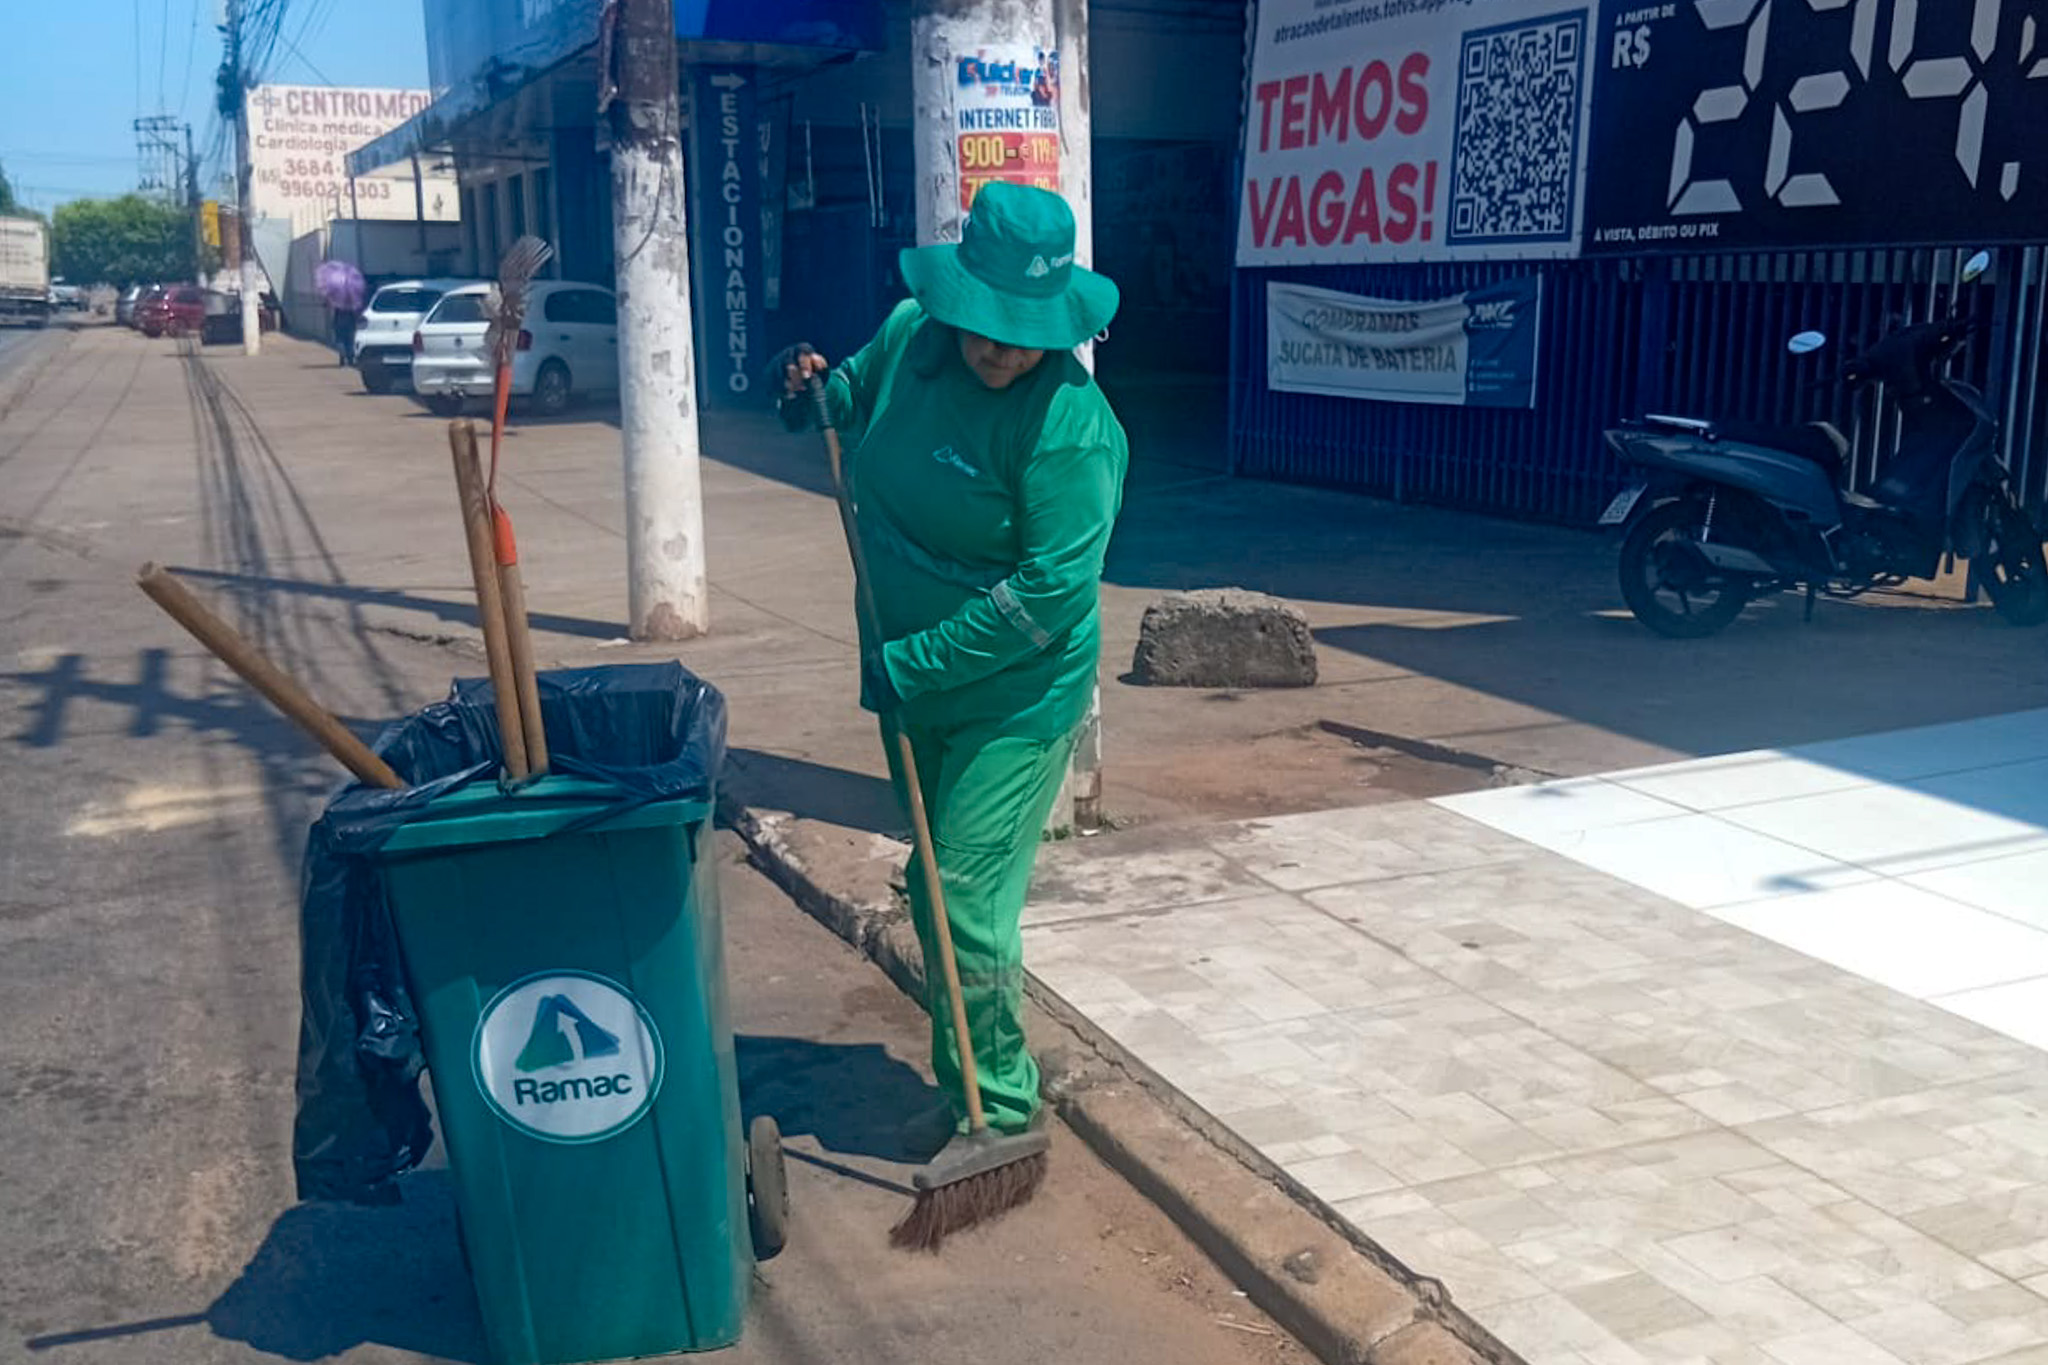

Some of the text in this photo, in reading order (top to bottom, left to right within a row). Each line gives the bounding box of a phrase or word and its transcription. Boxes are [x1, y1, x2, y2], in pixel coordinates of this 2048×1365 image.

[1661, 3, 1676, 19] DE
[1611, 24, 1651, 70] R$
[286, 90, 371, 118] CENTRO
[959, 108, 1030, 130] INTERNET
[1256, 52, 1430, 154] TEMOS
[963, 136, 1005, 168] 900
[1248, 160, 1438, 248] VAGAS!
[720, 93, 749, 393] ESTACIONAMENTO
[1680, 224, 1697, 238] OU
[1699, 222, 1719, 237] PIX
[1279, 340, 1457, 374] SUCATA DE BATERIA
[514, 1073, 633, 1106] Ramac
